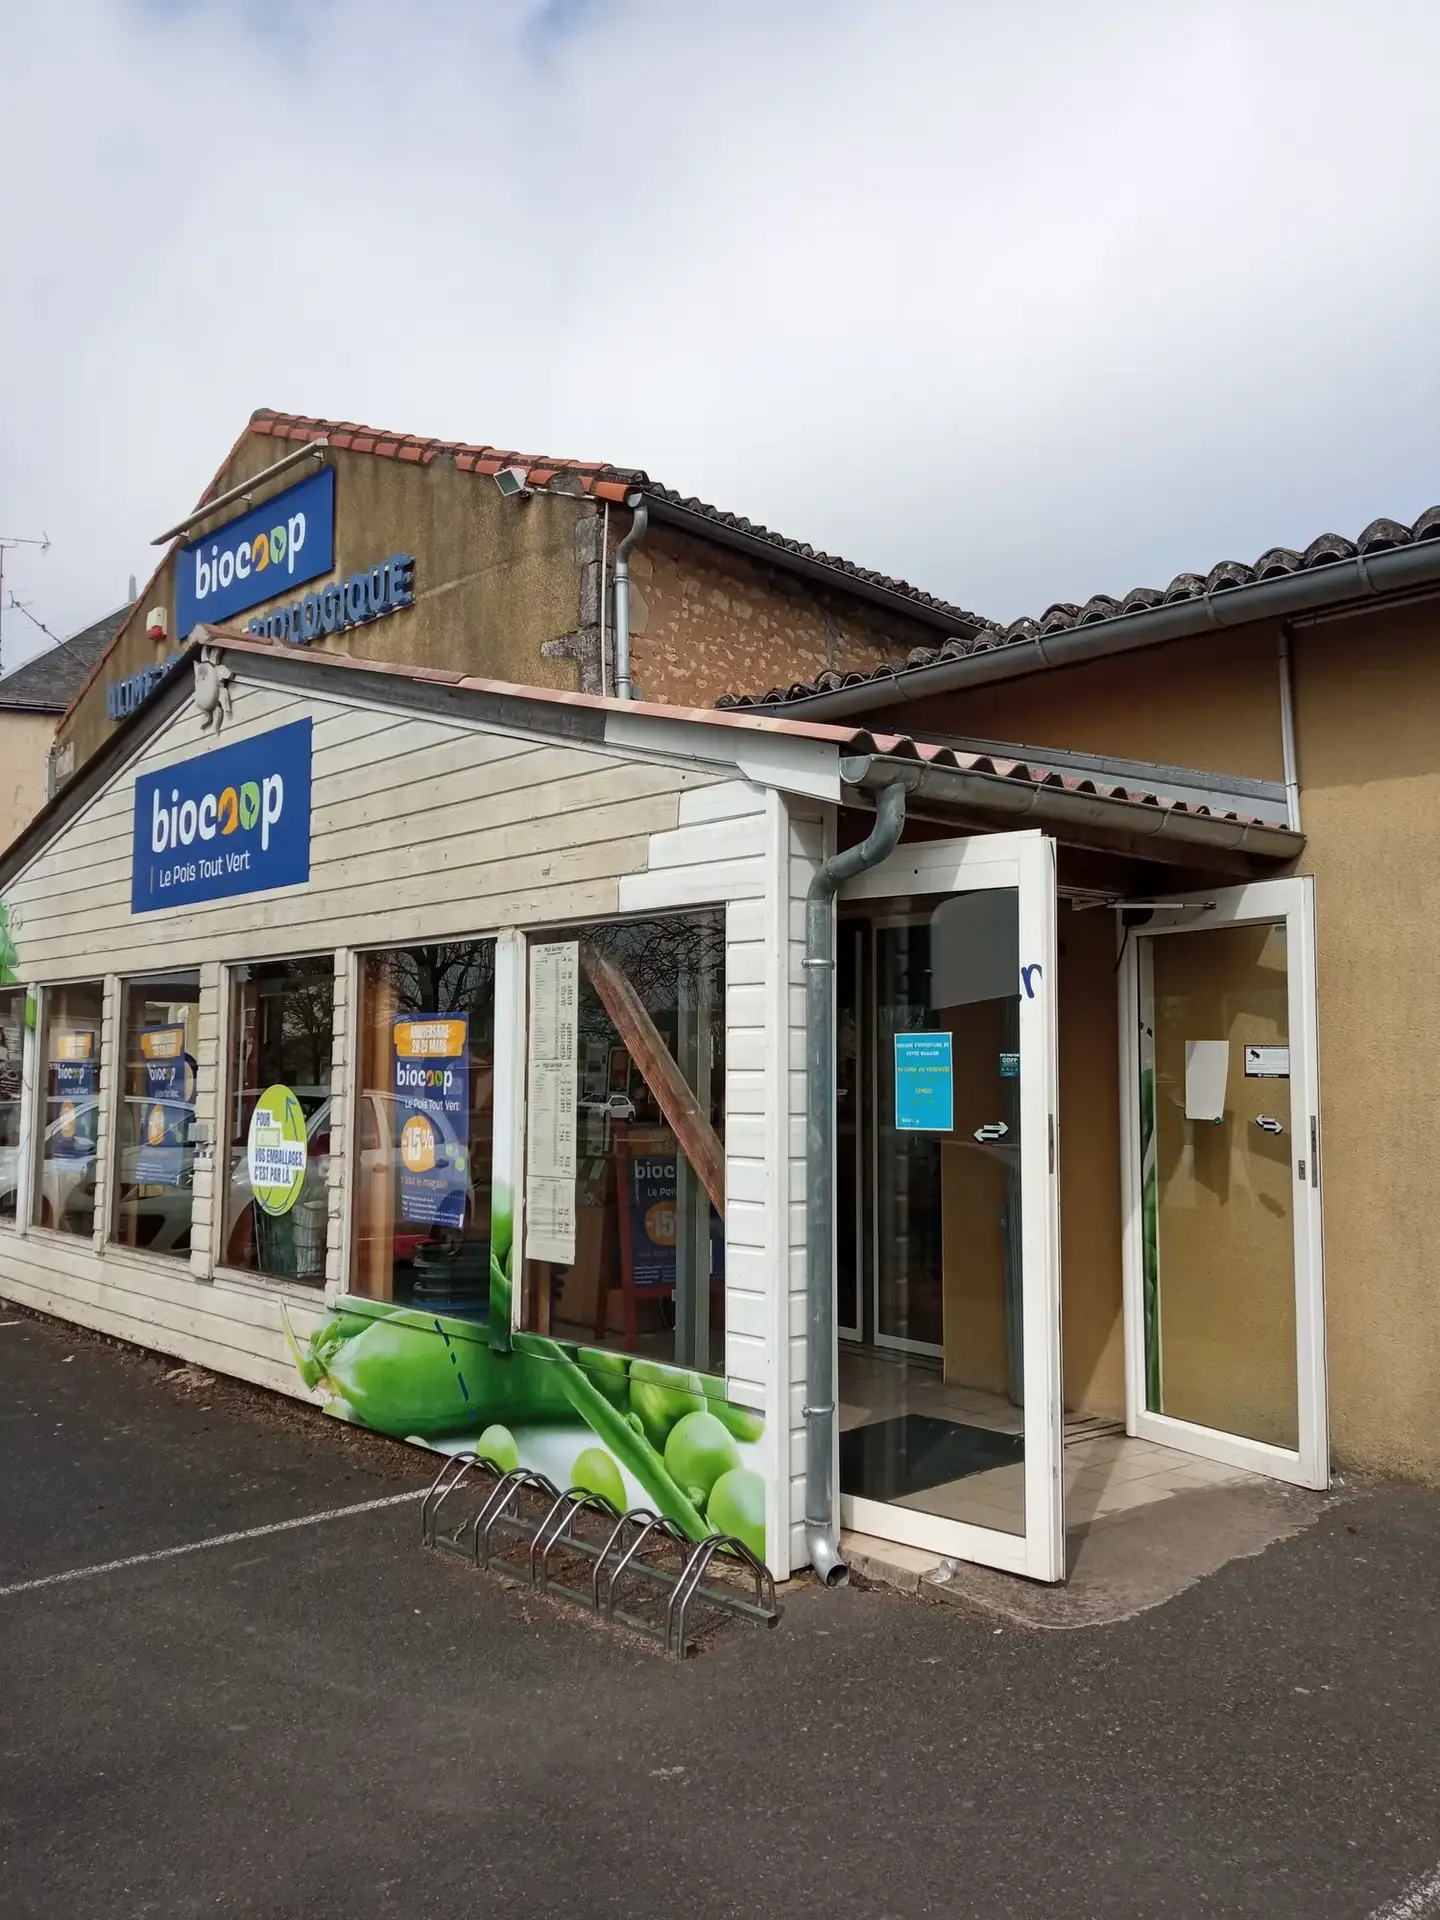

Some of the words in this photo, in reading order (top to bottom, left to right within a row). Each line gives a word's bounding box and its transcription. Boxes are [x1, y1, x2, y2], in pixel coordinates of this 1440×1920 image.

[195, 511, 306, 600] biocoop
[152, 773, 284, 853] biocoop
[159, 869, 172, 888] Le
[173, 862, 196, 885] Pois
[198, 855, 223, 879] Tout
[225, 849, 251, 873] Vert
[396, 1061, 453, 1096] biocoop
[428, 1099, 444, 1110] Tout
[444, 1100, 460, 1111] Vert
[255, 1111, 271, 1127] POUR
[634, 1159, 678, 1179] bioc
[647, 1187, 660, 1197] Le
